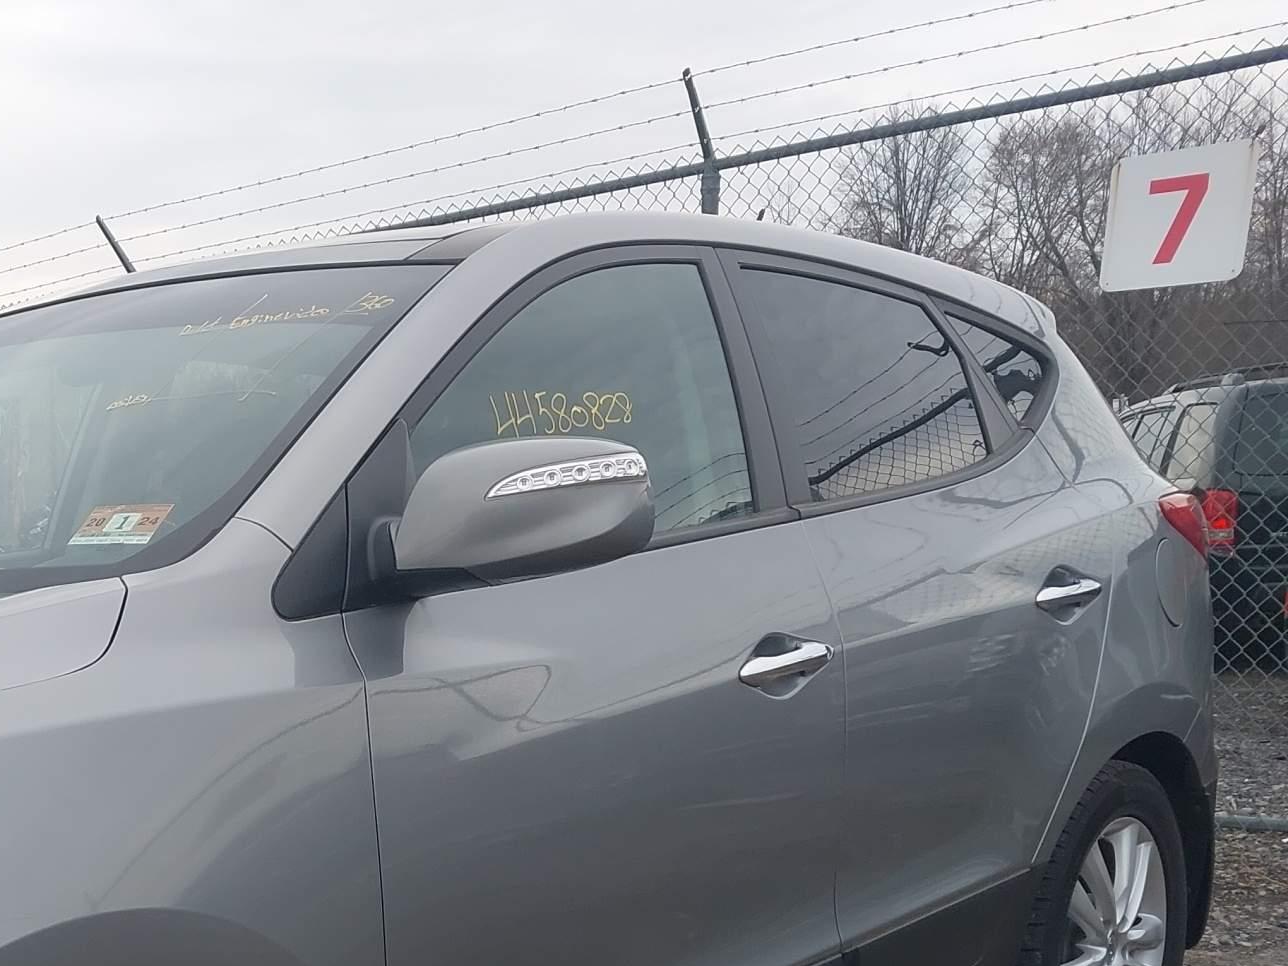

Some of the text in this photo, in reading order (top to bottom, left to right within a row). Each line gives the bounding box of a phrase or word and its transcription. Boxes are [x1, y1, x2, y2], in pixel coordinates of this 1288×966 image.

[1148, 172, 1210, 265] 7
[488, 388, 633, 440] 44580828
[85, 515, 160, 530] 20 1 24
